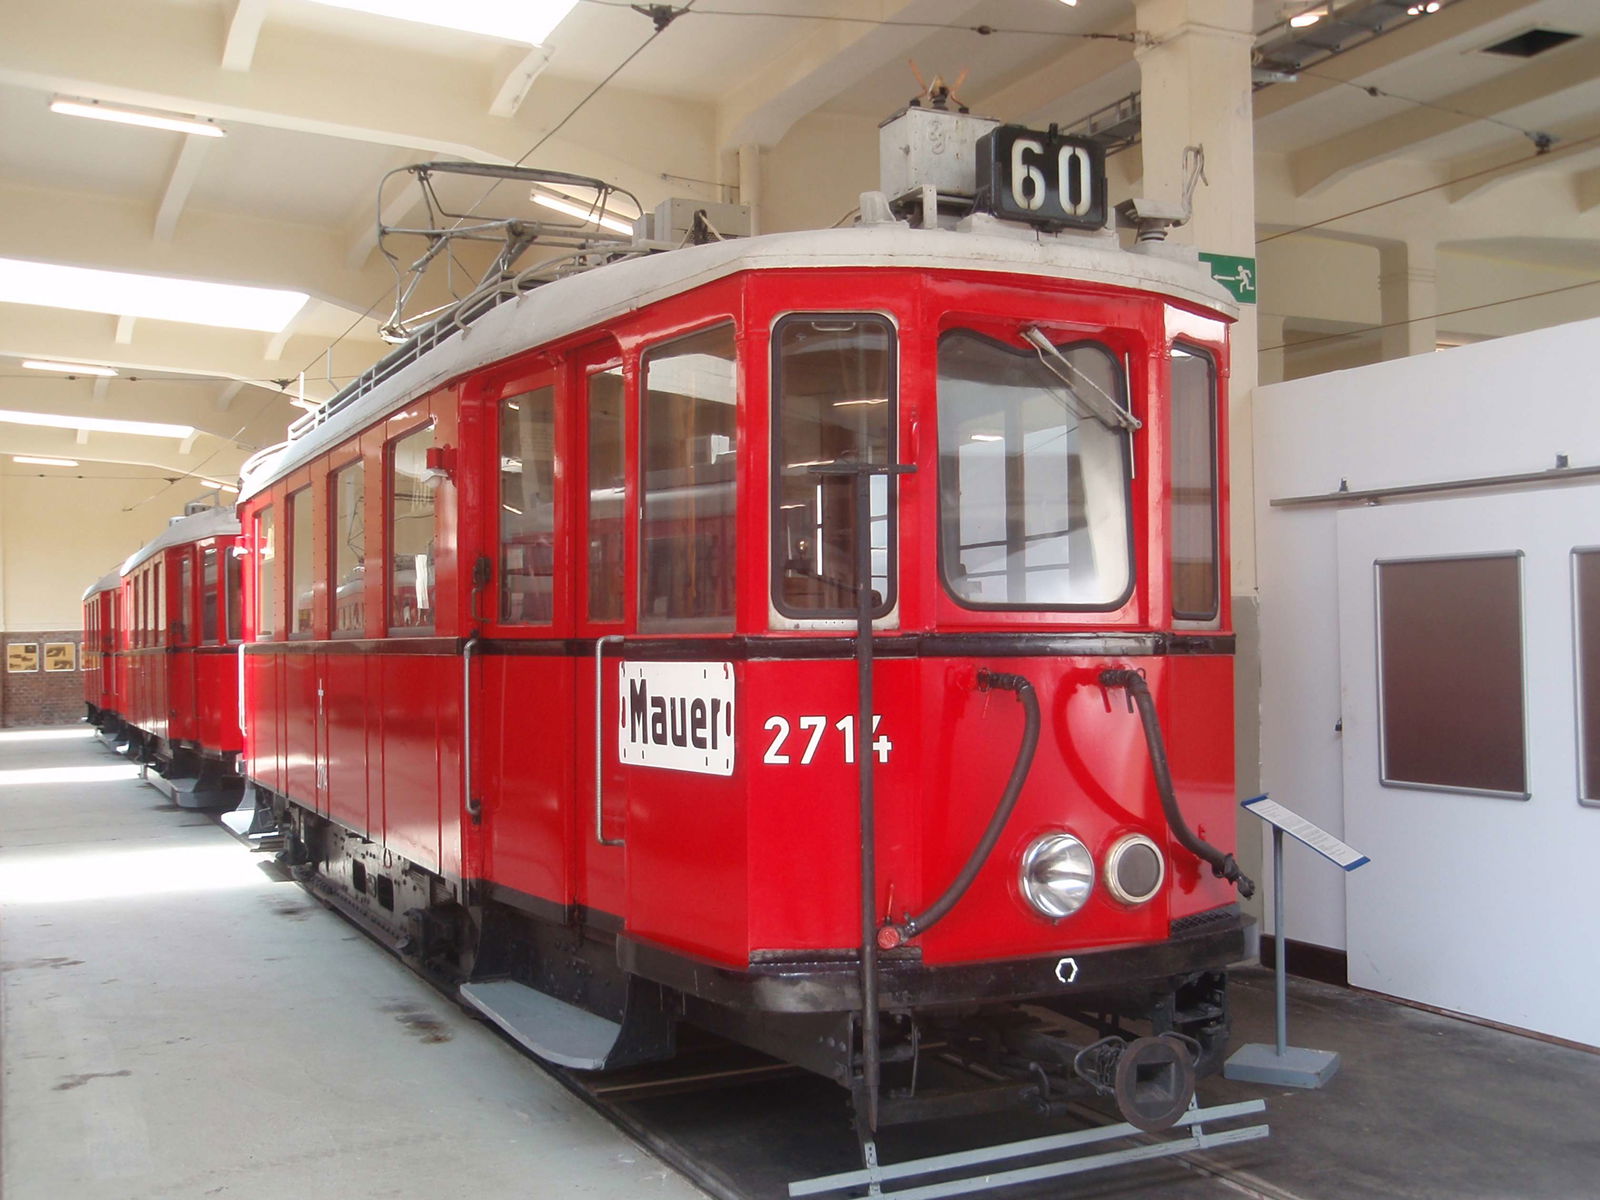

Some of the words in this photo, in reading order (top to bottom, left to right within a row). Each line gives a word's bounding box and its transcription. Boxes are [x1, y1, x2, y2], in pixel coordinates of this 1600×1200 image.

[1011, 139, 1092, 215] 60
[630, 678, 721, 750] Mauer
[763, 715, 892, 764] 2714
